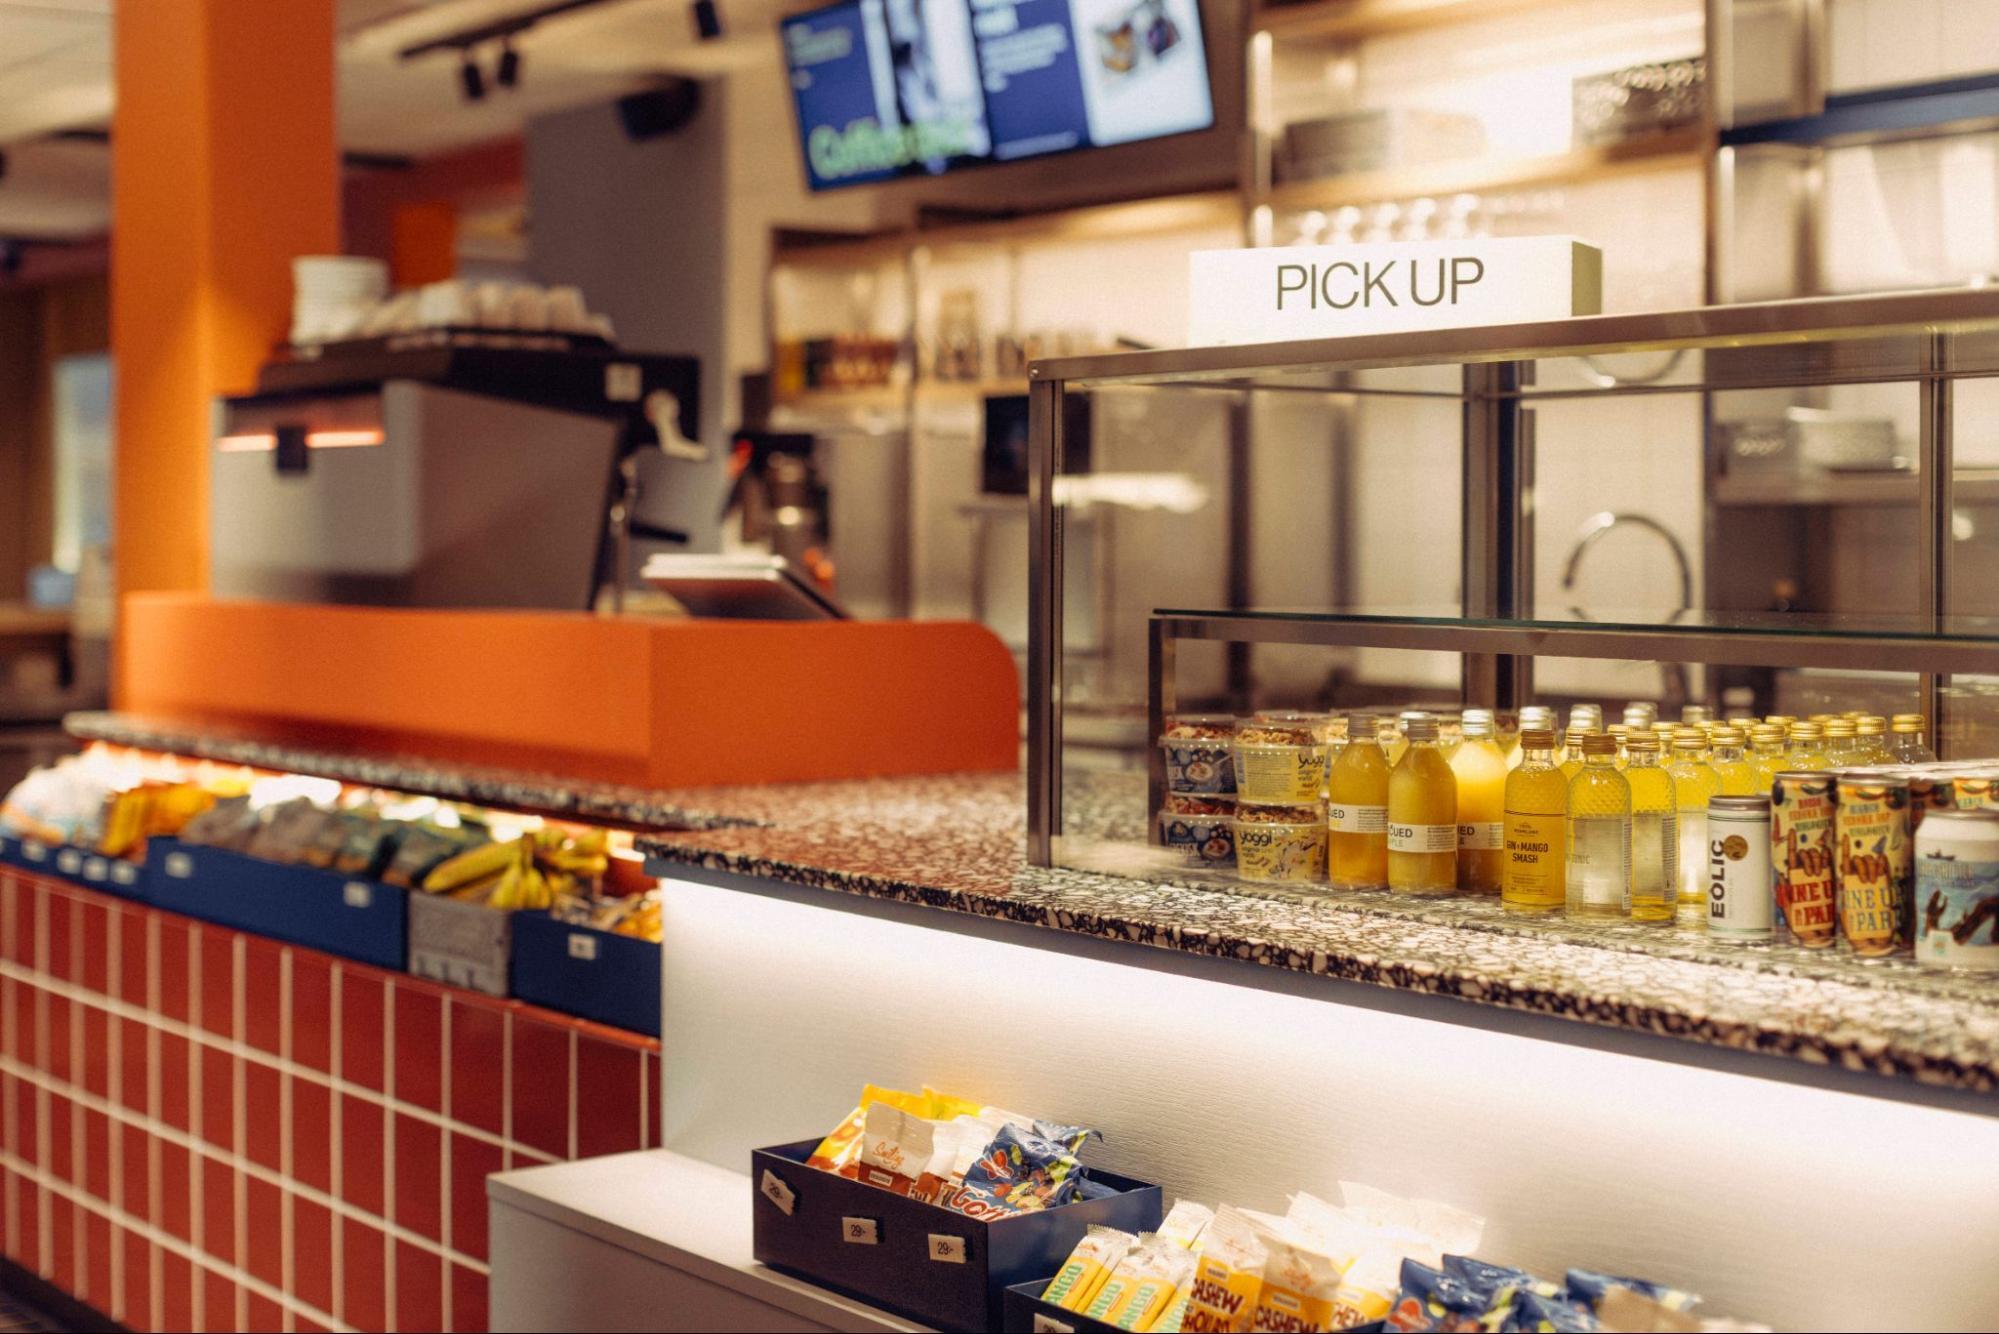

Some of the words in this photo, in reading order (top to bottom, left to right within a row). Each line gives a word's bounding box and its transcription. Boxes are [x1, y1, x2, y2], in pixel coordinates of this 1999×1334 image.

[1276, 261, 1399, 311] PICK
[1410, 257, 1485, 307] UP
[1520, 841, 1549, 853] MANGO
[1512, 852, 1539, 864] SMASH
[937, 1241, 954, 1255] 29:-
[1047, 1263, 1083, 1305] ANGO
